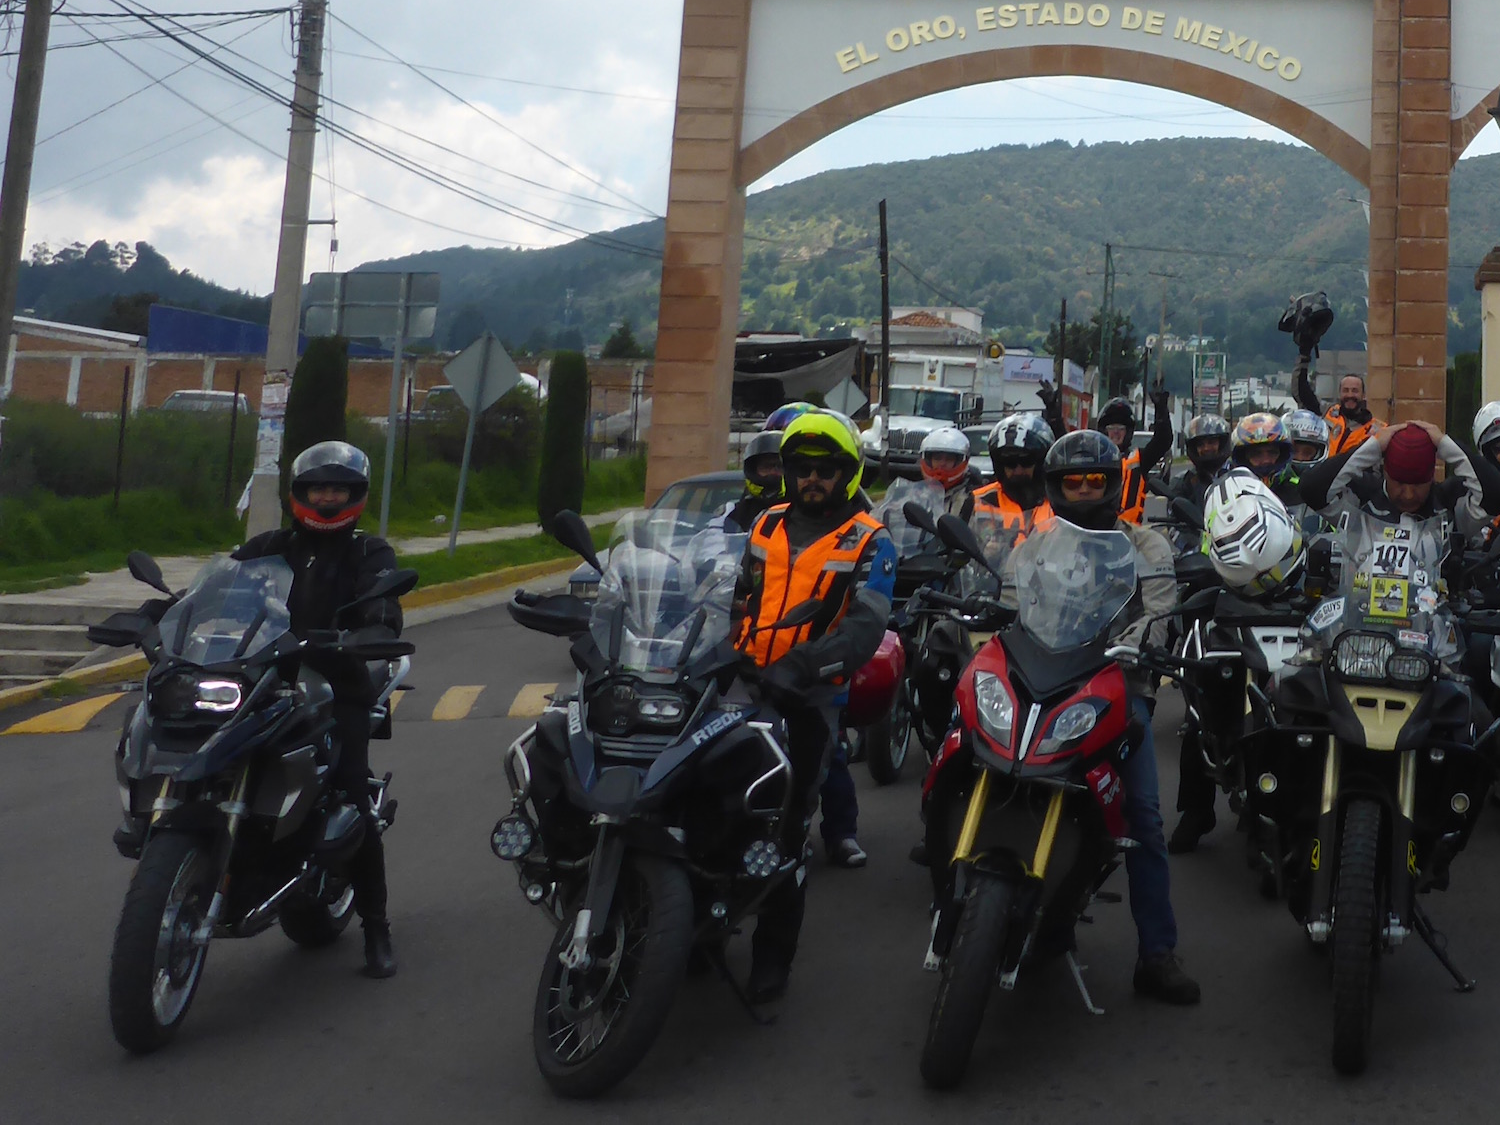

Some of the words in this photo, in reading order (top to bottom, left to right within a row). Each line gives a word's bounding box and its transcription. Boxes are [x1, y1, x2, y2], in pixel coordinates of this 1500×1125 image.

[835, 40, 879, 73] EL
[885, 14, 967, 54] ORO,
[975, 2, 1110, 32] ESTADO
[1121, 6, 1166, 35] DE
[1173, 16, 1302, 81] MEXICO
[1374, 544, 1409, 568] 107
[1322, 600, 1341, 615] GUYS
